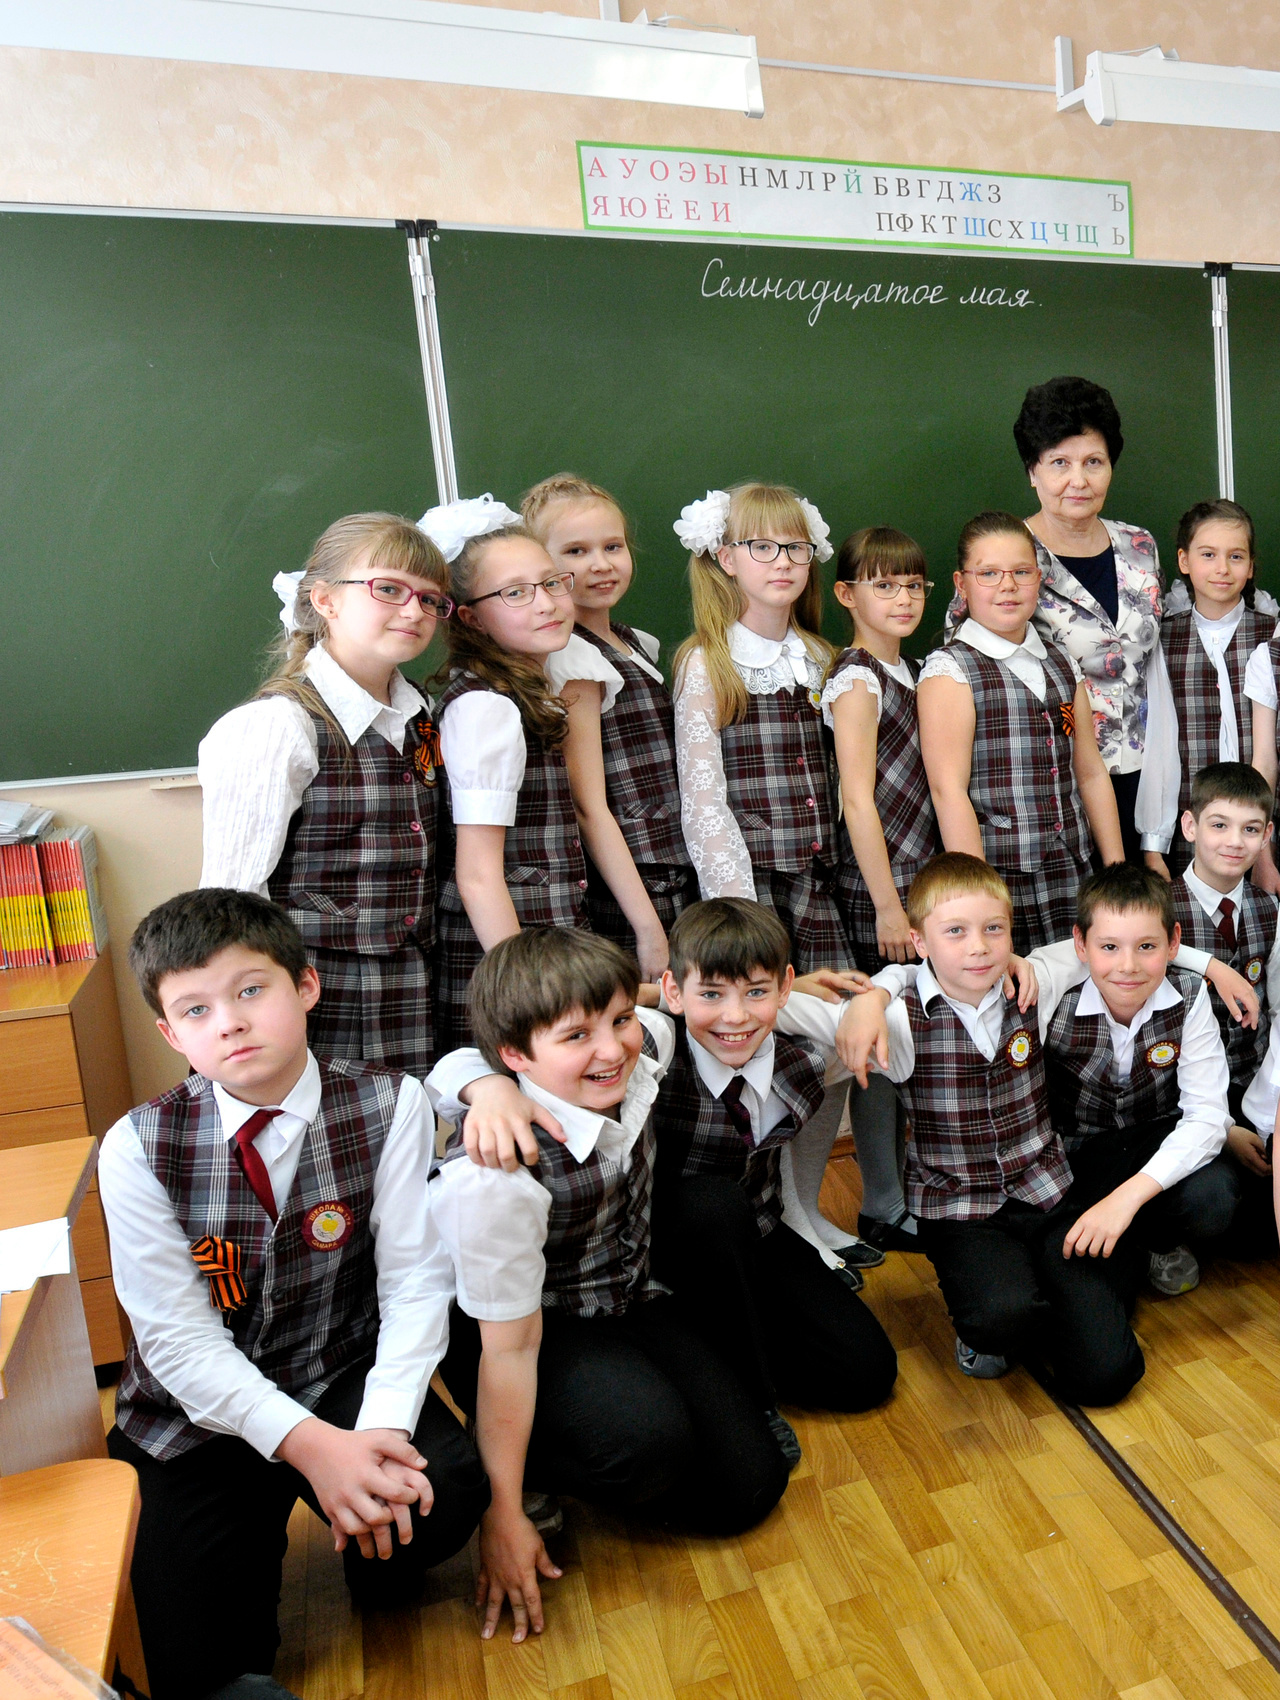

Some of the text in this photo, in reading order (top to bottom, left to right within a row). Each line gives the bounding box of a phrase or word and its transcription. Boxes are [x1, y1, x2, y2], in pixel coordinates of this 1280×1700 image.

[587, 156, 608, 178] А
[618, 158, 638, 179] У
[650, 160, 669, 181] О
[679, 162, 696, 182] Э
[705, 164, 728, 185] Ы
[1108, 193, 1124, 212] Ъ
[591, 196, 609, 216] Я
[620, 197, 647, 218] Ю
[655, 193, 673, 219] Ё
[684, 200, 700, 220] Е
[712, 201, 731, 222] И
[1112, 228, 1125, 245] Ь
[701, 258, 948, 327] Семнадцатое
[309, 1204, 335, 1221] ШКОЛА
